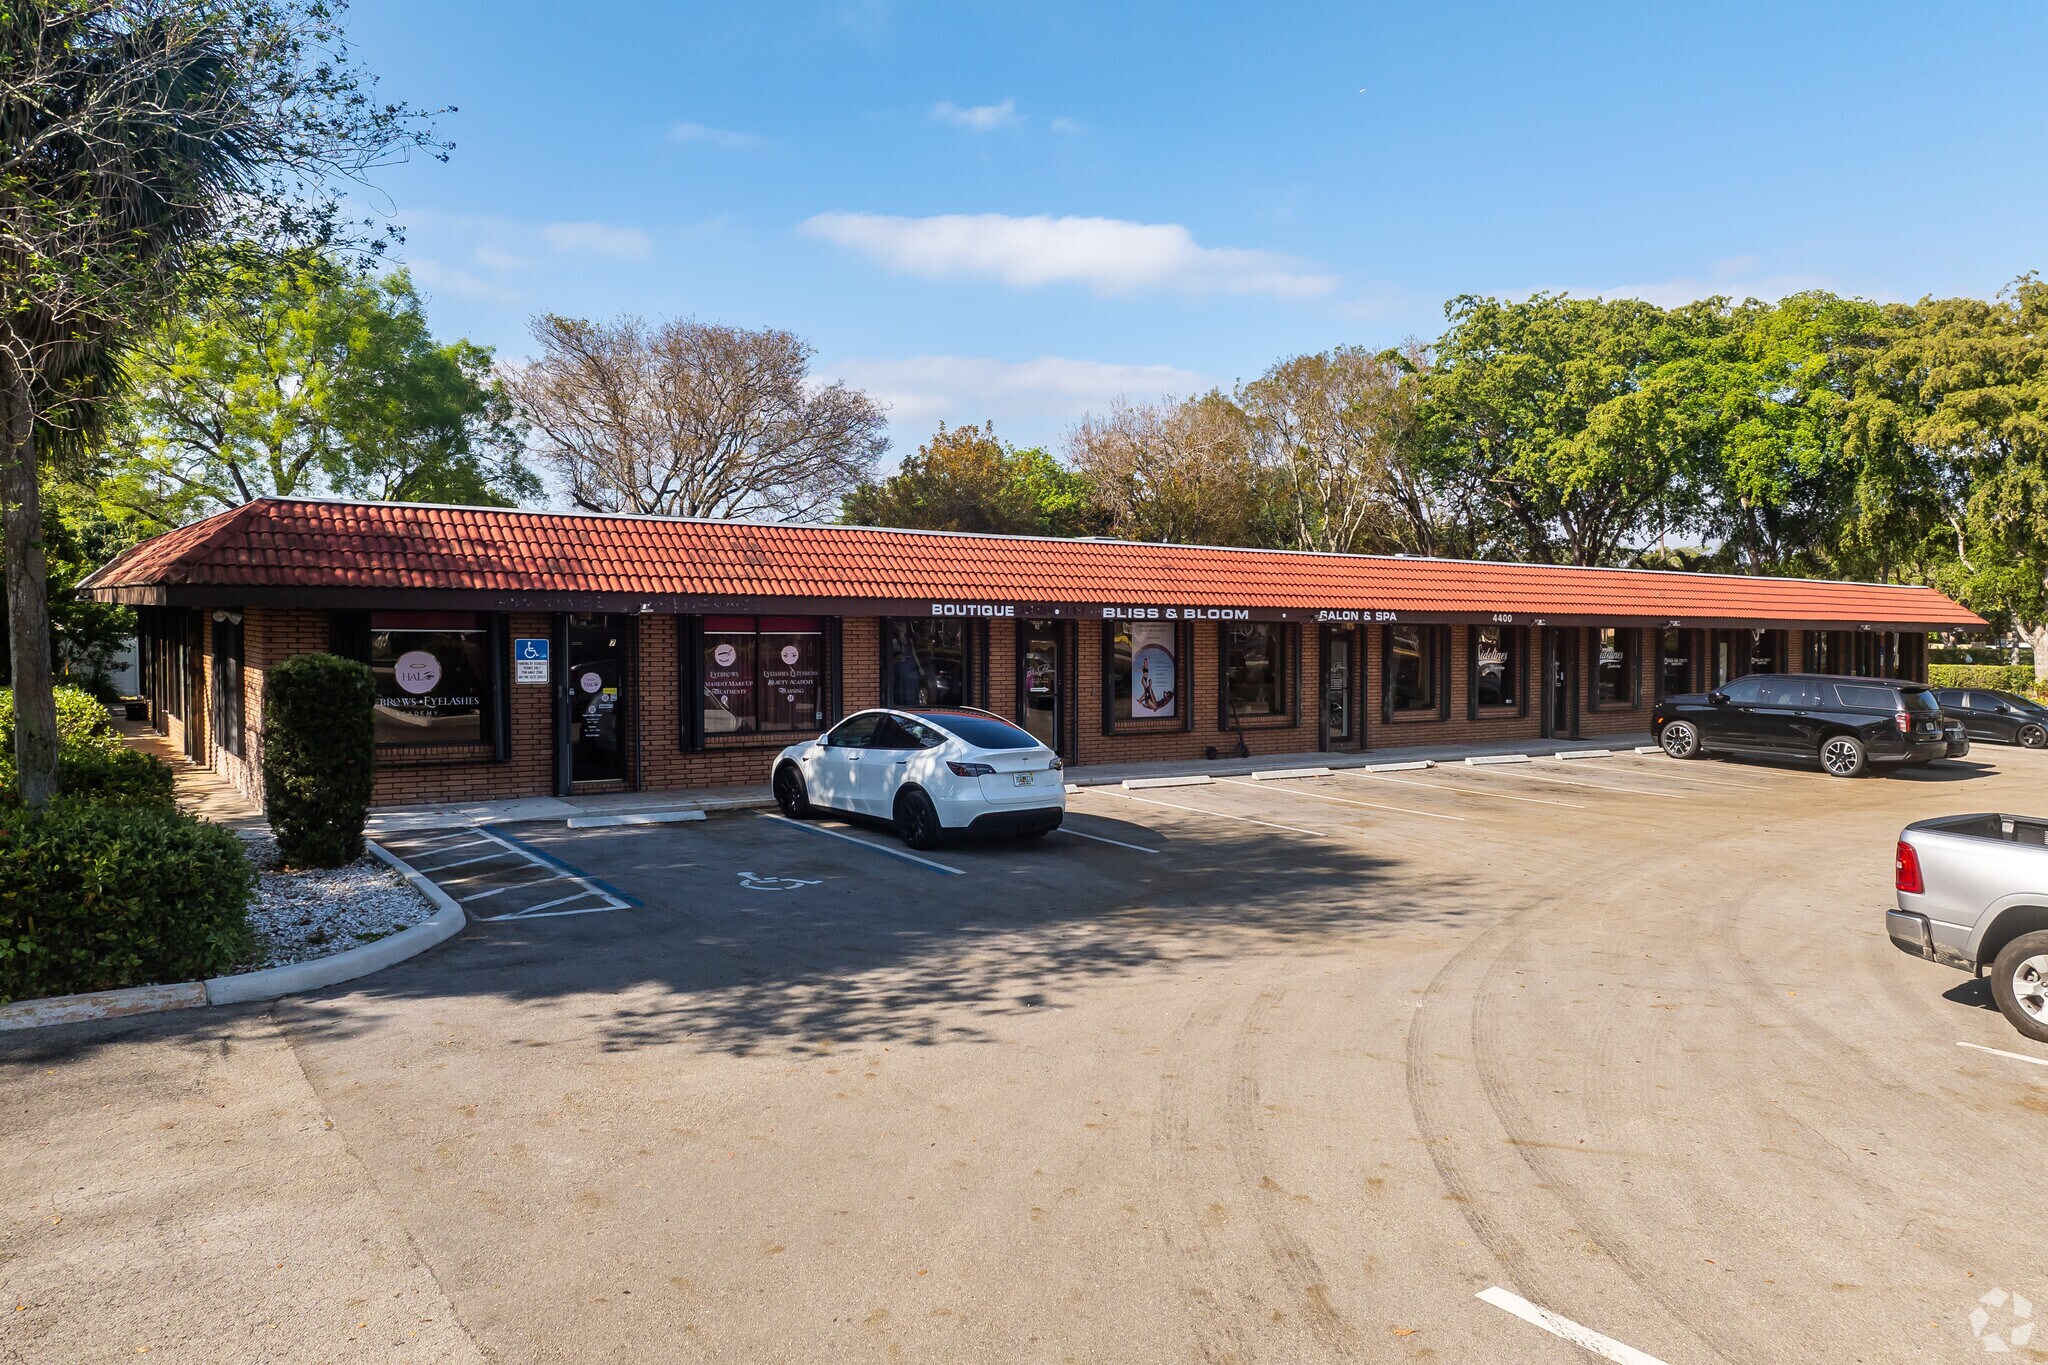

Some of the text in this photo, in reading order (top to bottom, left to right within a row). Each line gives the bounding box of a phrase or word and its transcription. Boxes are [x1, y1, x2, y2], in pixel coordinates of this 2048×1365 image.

[932, 604, 1014, 616] BOUTIQUE
[1102, 608, 1249, 620] BLISS & BLOOM
[1320, 610, 1397, 621] SALON & SPA
[1492, 614, 1512, 622] 4400
[1478, 644, 1508, 662] Sidelines
[424, 696, 480, 708] EYELASHES
